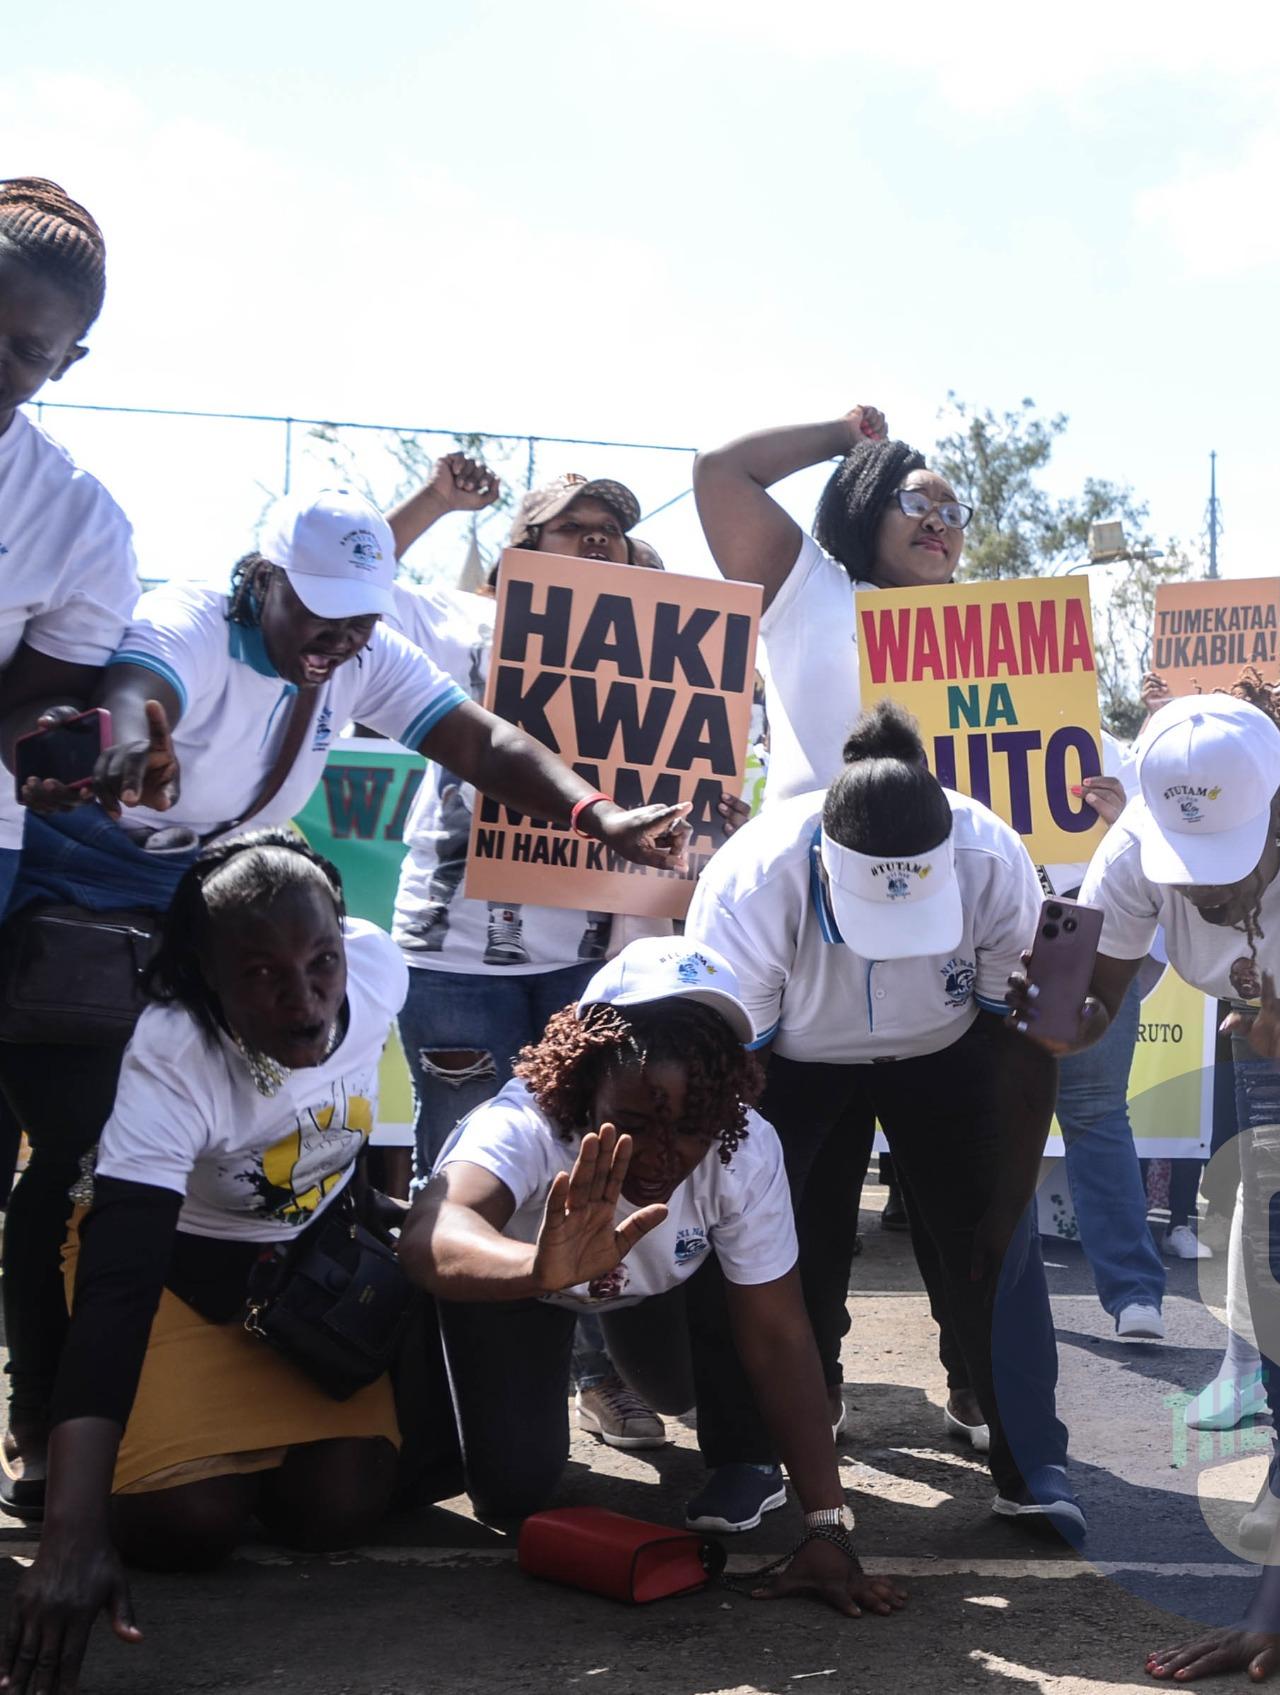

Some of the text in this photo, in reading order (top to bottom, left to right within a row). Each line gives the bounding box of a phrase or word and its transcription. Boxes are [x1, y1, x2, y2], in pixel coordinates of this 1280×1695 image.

[500, 579, 751, 693] HAKI
[861, 598, 1094, 684] WAMAMA
[1158, 604, 1277, 636] TUMEKATAA
[1155, 631, 1278, 670] UKABILA!
[494, 665, 737, 776] KWA
[947, 683, 1018, 729] NA
[921, 726, 1102, 836] UTO
[475, 828, 506, 860] NI
[512, 832, 579, 868] HAKI
[1136, 1023, 1183, 1043] RUTO
